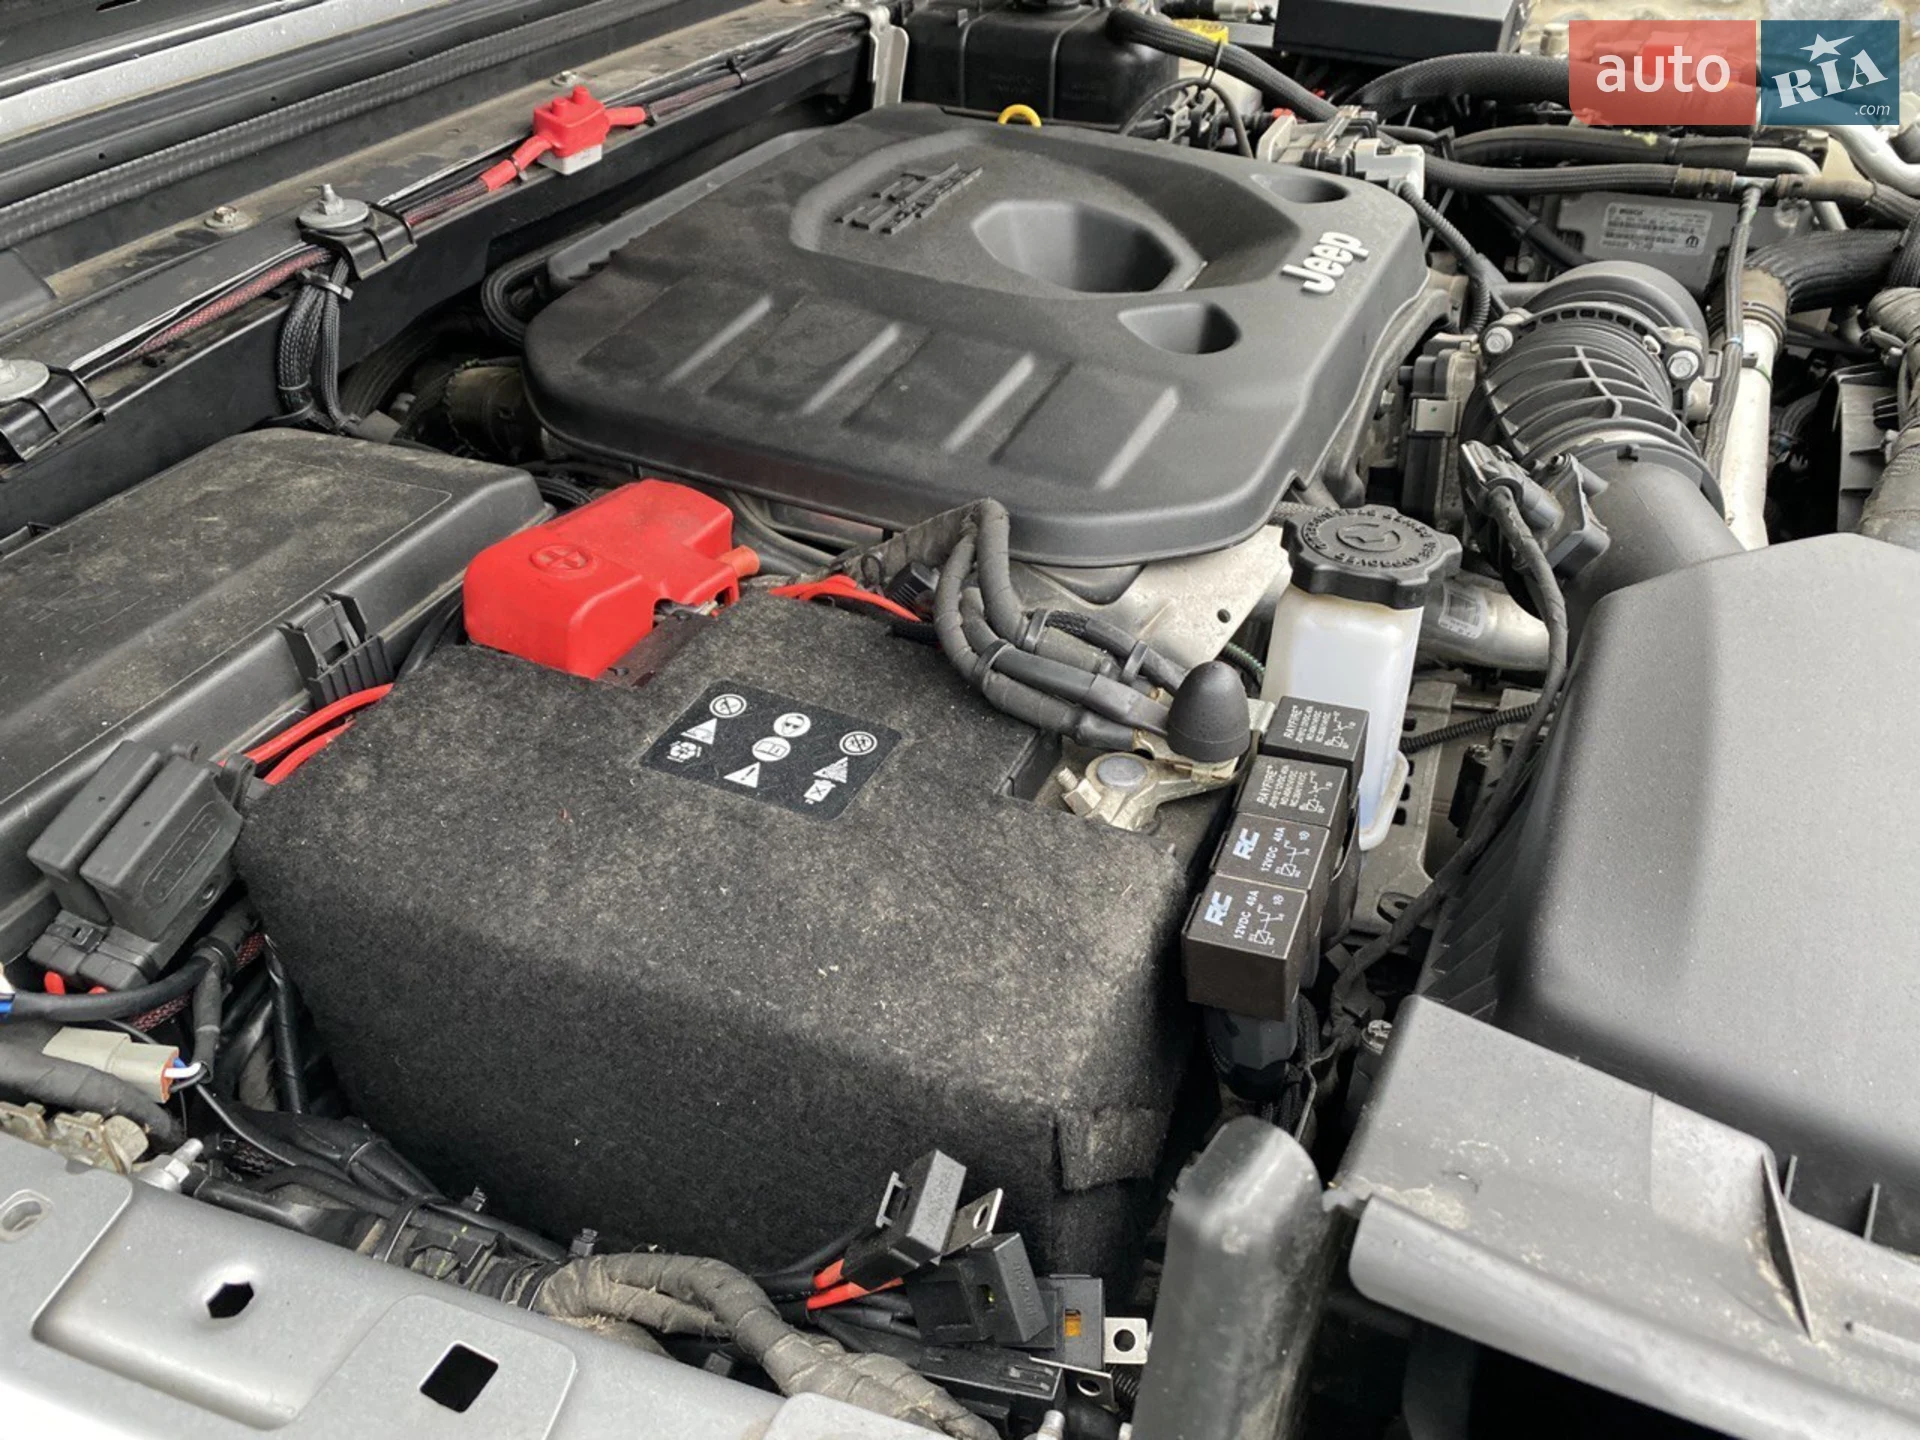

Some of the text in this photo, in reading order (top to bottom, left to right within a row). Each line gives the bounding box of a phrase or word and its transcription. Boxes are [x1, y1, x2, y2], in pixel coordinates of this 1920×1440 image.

[1282, 231, 1370, 294] Jeep
[1260, 845, 1279, 872] 12VDC
[1204, 890, 1233, 927] RC
[1233, 911, 1252, 939] 12VDC
